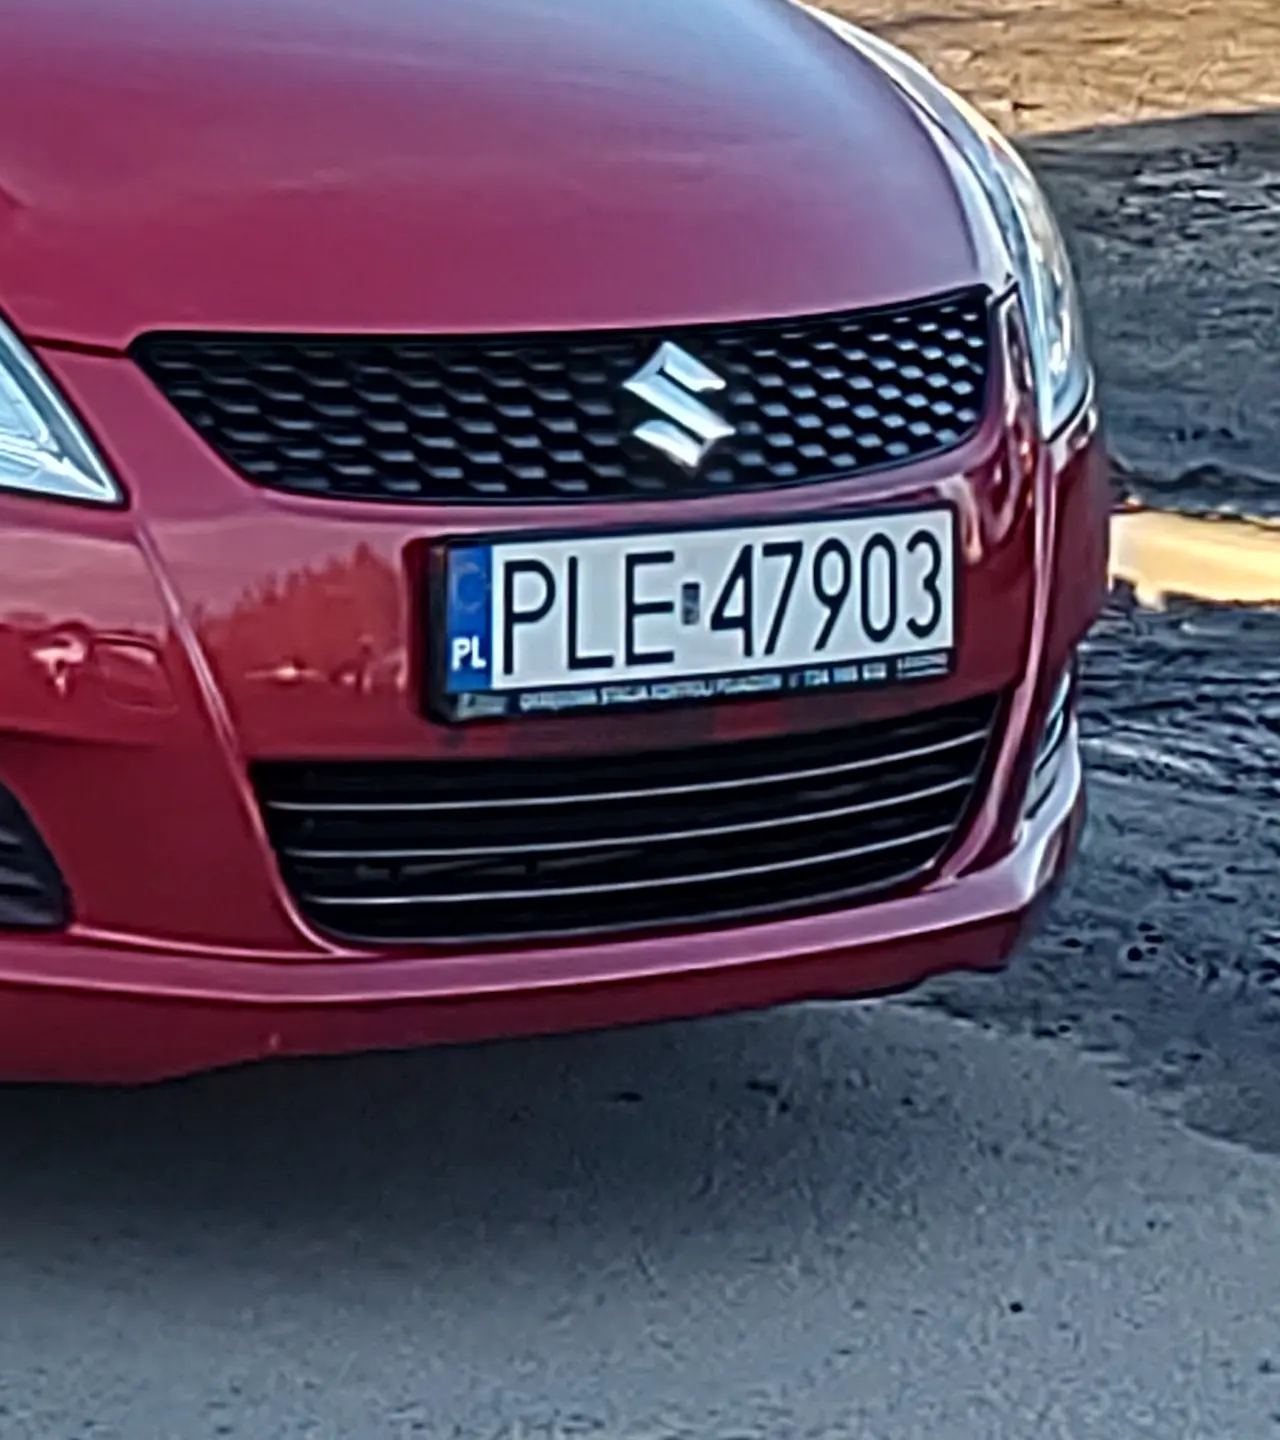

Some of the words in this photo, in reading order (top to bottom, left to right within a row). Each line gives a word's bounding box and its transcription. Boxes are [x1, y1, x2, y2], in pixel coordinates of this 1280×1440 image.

[502, 549, 675, 675] PLE
[710, 530, 942, 657] 47903
[451, 636, 487, 671] PL
